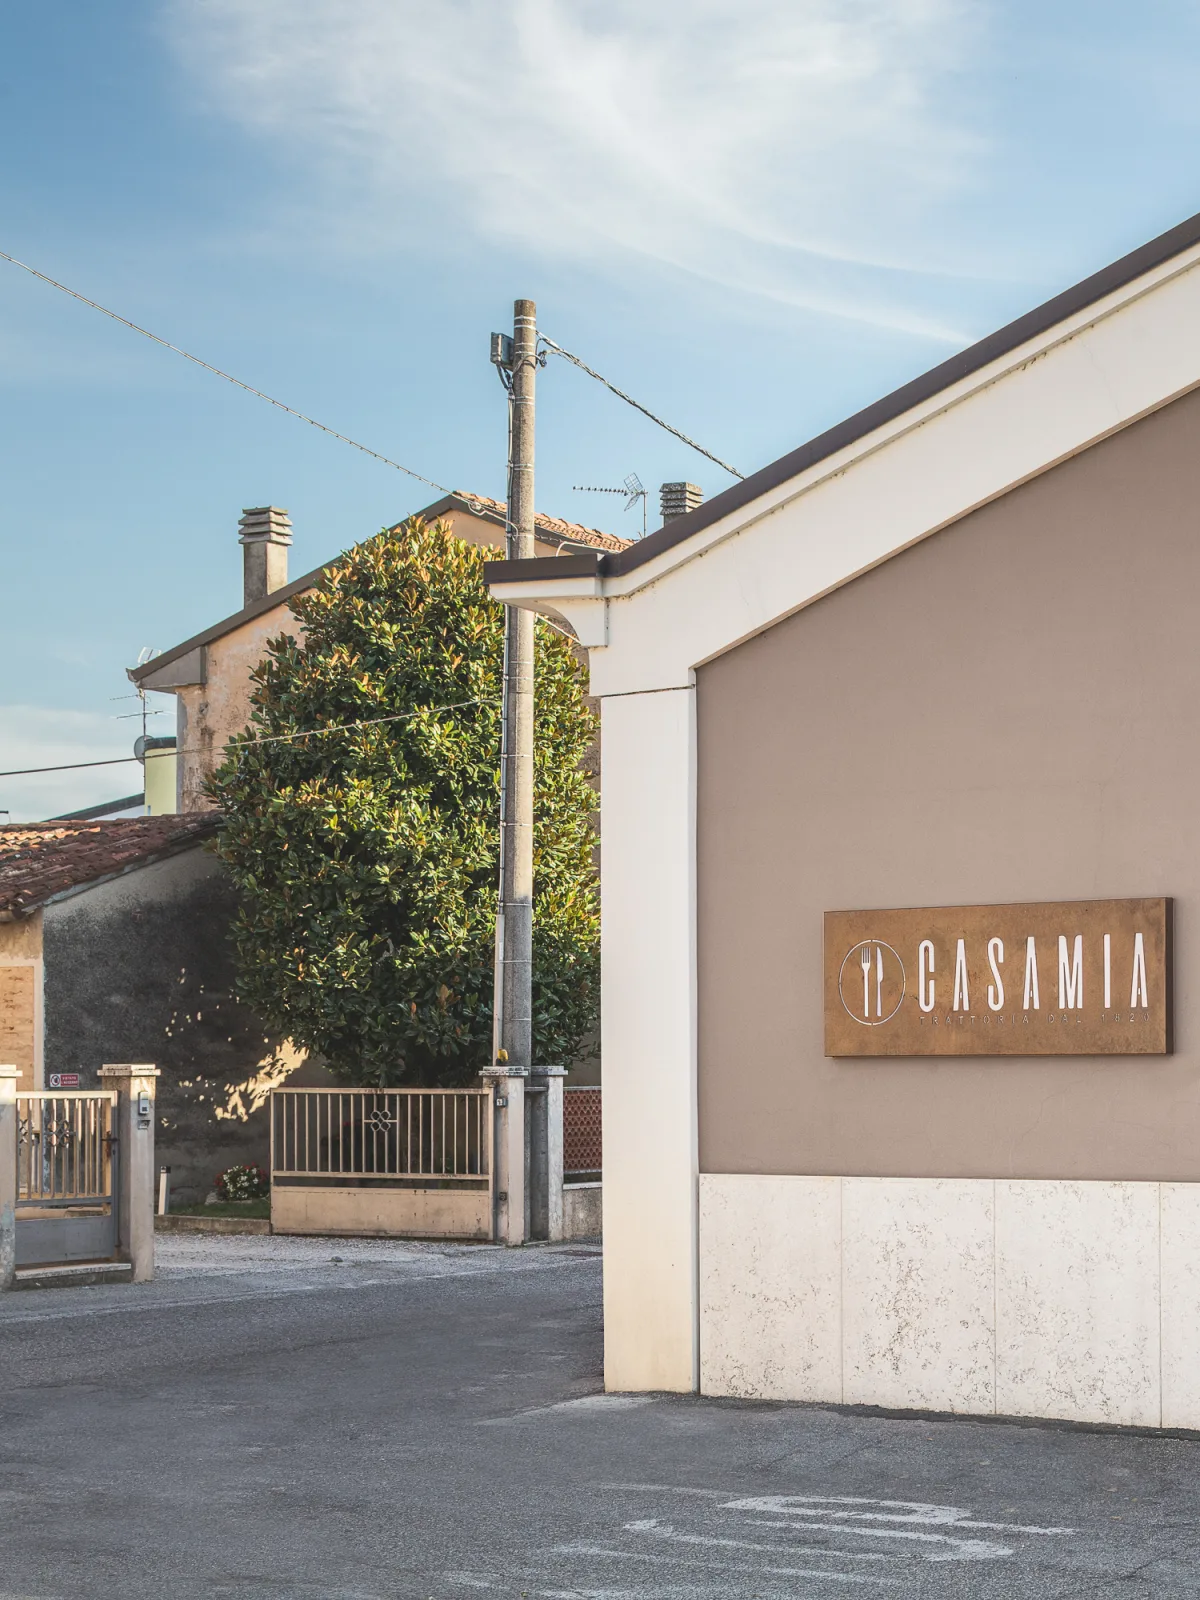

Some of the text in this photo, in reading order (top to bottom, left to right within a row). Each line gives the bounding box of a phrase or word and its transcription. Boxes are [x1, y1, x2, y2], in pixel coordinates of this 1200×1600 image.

[918, 932, 1149, 1013] CASAMIA
[919, 1012, 1150, 1026] TRATTORIA DAL 1820
